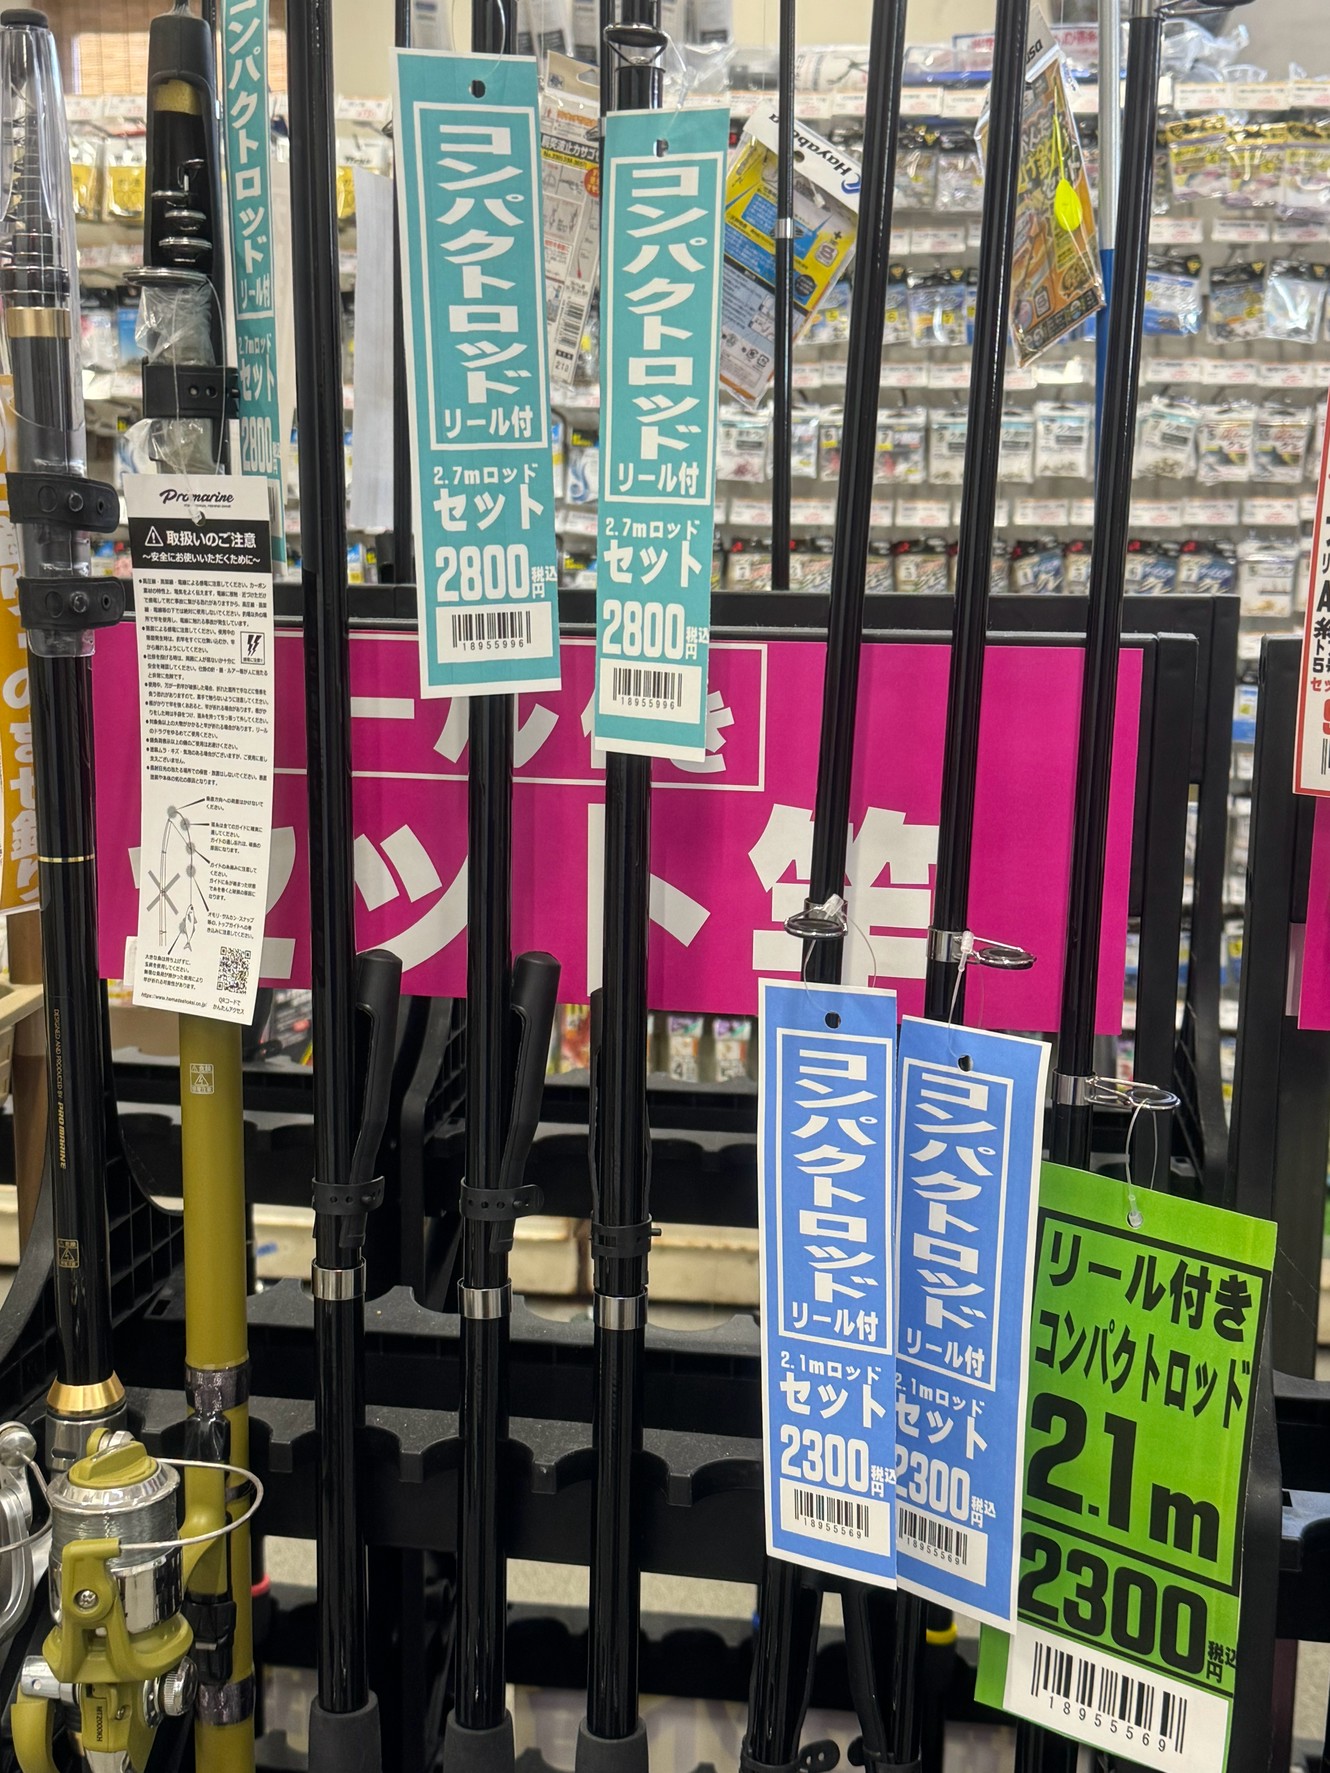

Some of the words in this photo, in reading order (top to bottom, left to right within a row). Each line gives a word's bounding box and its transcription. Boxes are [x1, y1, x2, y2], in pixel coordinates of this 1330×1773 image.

[228, 0, 265, 274] ンパクトロッド
[437, 124, 532, 404] コンパクトロッド
[240, 273, 271, 310] リール付
[622, 166, 710, 459] コンパクトロッド
[241, 354, 275, 402] セット
[241, 416, 273, 475] 2800
[444, 405, 534, 440] リール付
[433, 463, 538, 485] 2.7mロッド
[618, 462, 700, 495] リール付
[433, 484, 544, 532] セット
[605, 518, 700, 539] 2.7mロッド
[166, 530, 257, 549] 取扱いのご注意
[435, 544, 530, 602] 2800
[531, 565, 558, 583] 税込
[603, 540, 702, 588] セット
[531, 583, 545, 599] 円
[462, 638, 525, 652] 18955996
[603, 599, 685, 660] 2800
[685, 644, 698, 660] 円
[620, 697, 676, 711] 18955996
[59, 1125, 67, 1170] MARINE
[791, 1049, 879, 1302] コンパクトロッド
[910, 1072, 996, 1330] コンパクトロッド
[1049, 1232, 1254, 1340] リール付き
[791, 1302, 880, 1343] リール付
[780, 1349, 884, 1382] 2.1mロッド
[906, 1330, 985, 1374] リール付
[1036, 1310, 1252, 1428] コンパクトロッド
[779, 1372, 887, 1430] セット
[895, 1397, 988, 1461] セット
[780, 1424, 868, 1493] 2300
[871, 1482, 885, 1498] 円
[896, 1453, 971, 1517] 2300
[803, 1517, 863, 1540] 18955569
[971, 1496, 996, 1518] 税込
[971, 1511, 985, 1528] 円
[906, 1538, 962, 1566] 18955569
[1022, 1532, 1207, 1676] 2300
[1207, 1662, 1224, 1684] 円
[1048, 1694, 1168, 1754] 18955569
